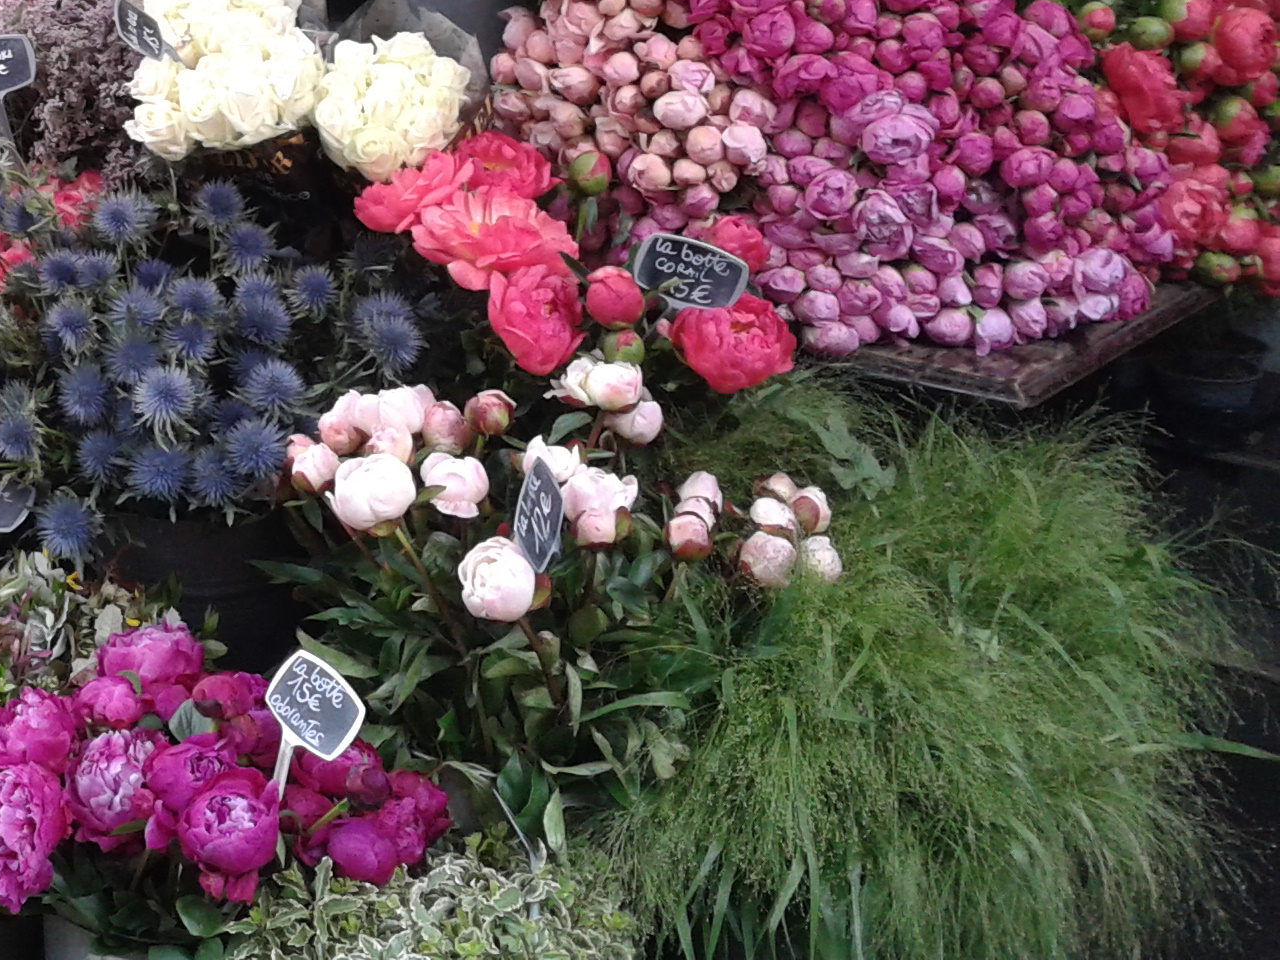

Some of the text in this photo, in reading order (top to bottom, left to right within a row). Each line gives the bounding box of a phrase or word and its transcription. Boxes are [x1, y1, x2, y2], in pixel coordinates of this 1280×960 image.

[680, 247, 730, 276] botte
[530, 492, 552, 554] 12€
[286, 674, 322, 712] 15€
[309, 665, 343, 709] botte
